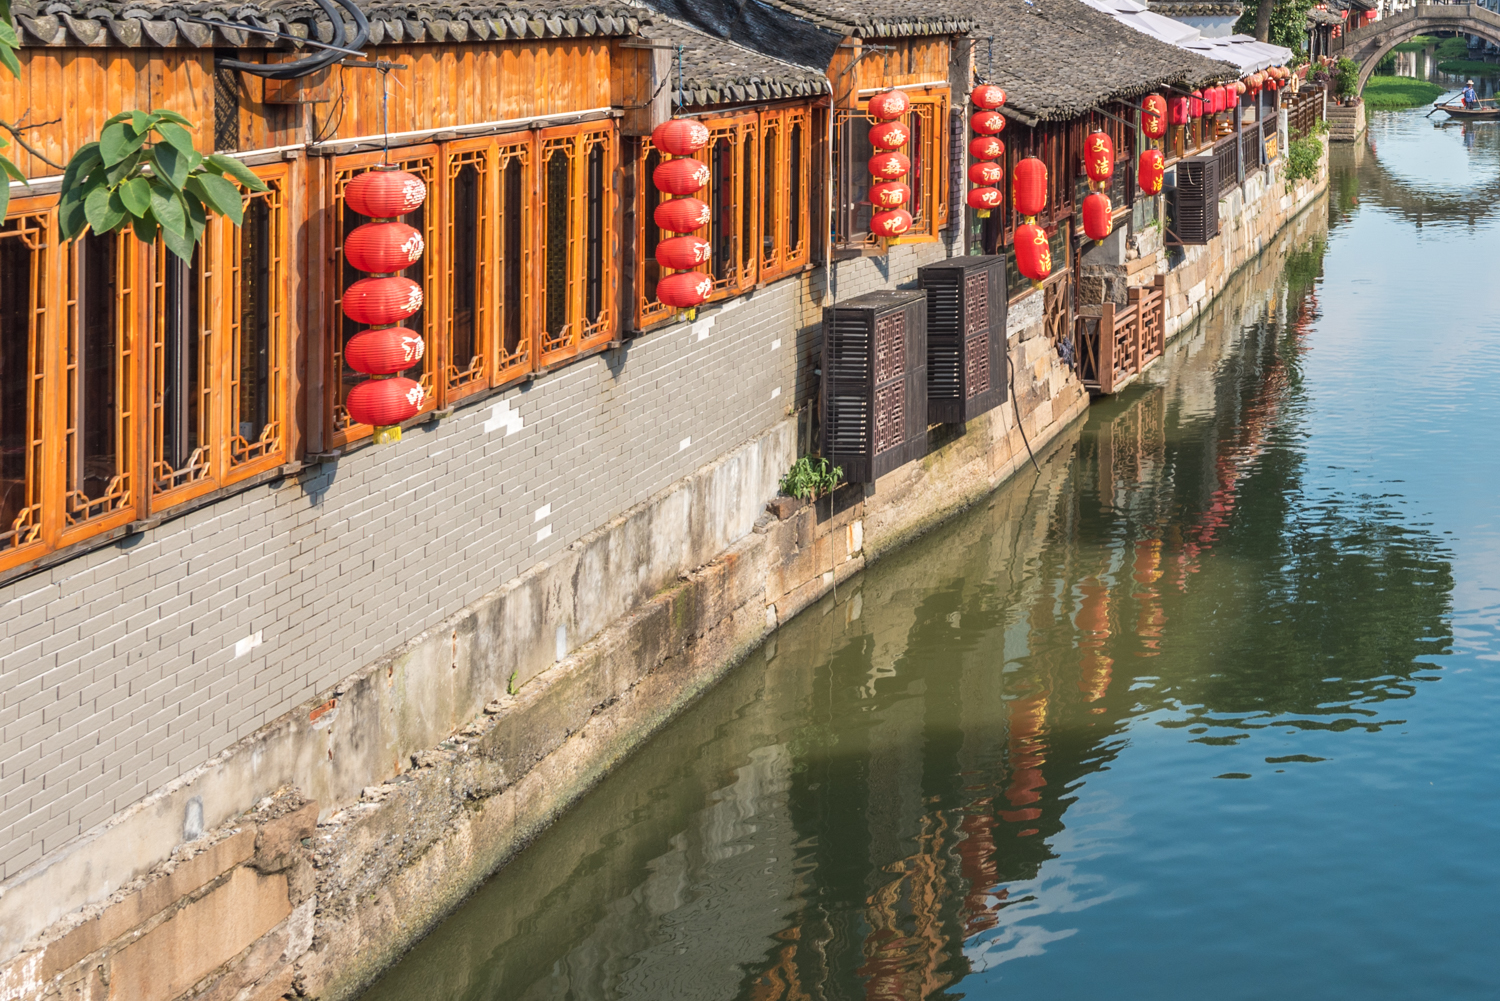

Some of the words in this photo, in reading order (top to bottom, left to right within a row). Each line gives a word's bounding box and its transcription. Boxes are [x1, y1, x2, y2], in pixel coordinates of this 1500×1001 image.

[1146, 99, 1160, 133] 文洁
[1092, 138, 1109, 174] 文洁
[1153, 156, 1164, 191] 文洁
[1034, 229, 1052, 272] 文洁
